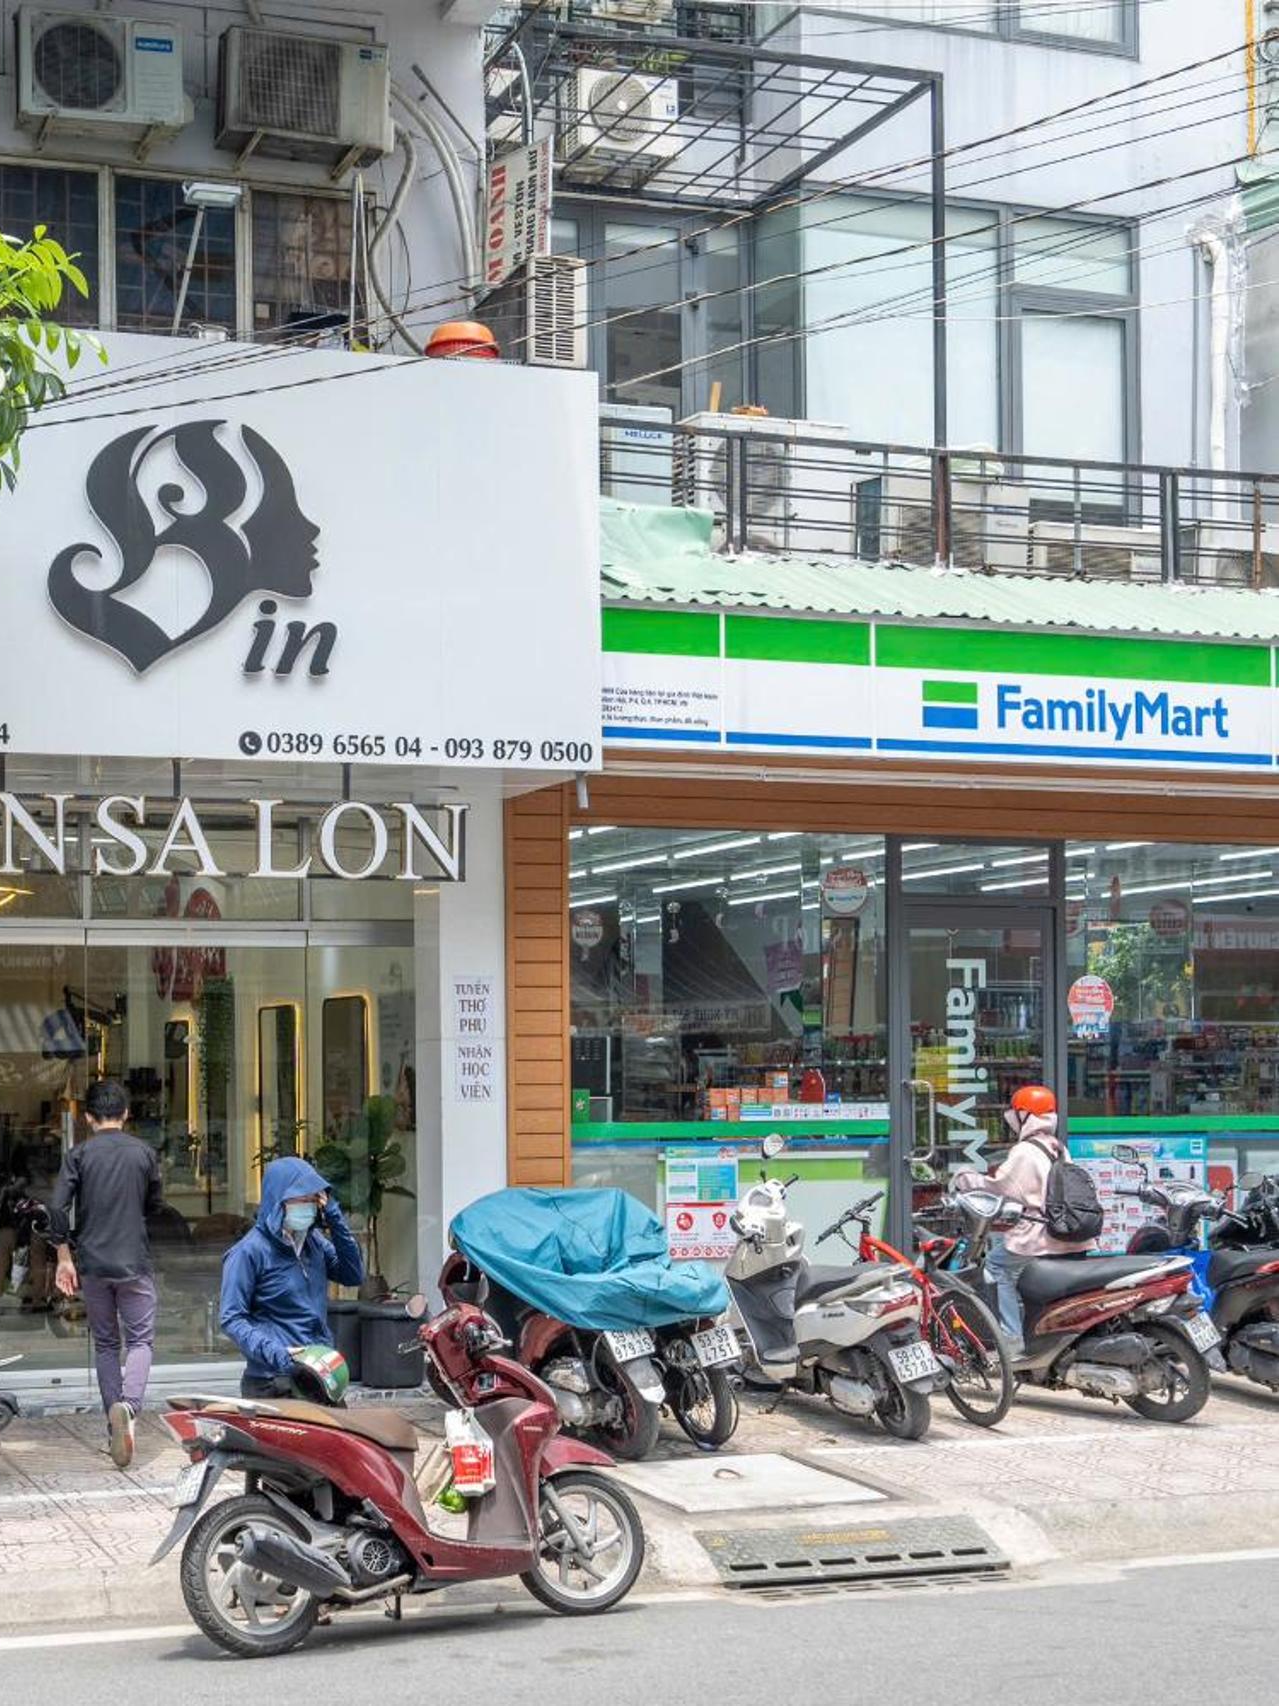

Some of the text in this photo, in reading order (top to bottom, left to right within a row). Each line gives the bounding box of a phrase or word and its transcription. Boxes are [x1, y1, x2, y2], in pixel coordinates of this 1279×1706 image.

[997, 684, 1228, 741] FamilyMart
[268, 732, 323, 755] 0389
[333, 734, 385, 757] 6565
[395, 735, 422, 759] 04
[444, 737, 484, 760] 093
[493, 738, 532, 762] 879
[541, 740, 593, 764] 0500
[936, 958, 989, 1176] FamilyM
